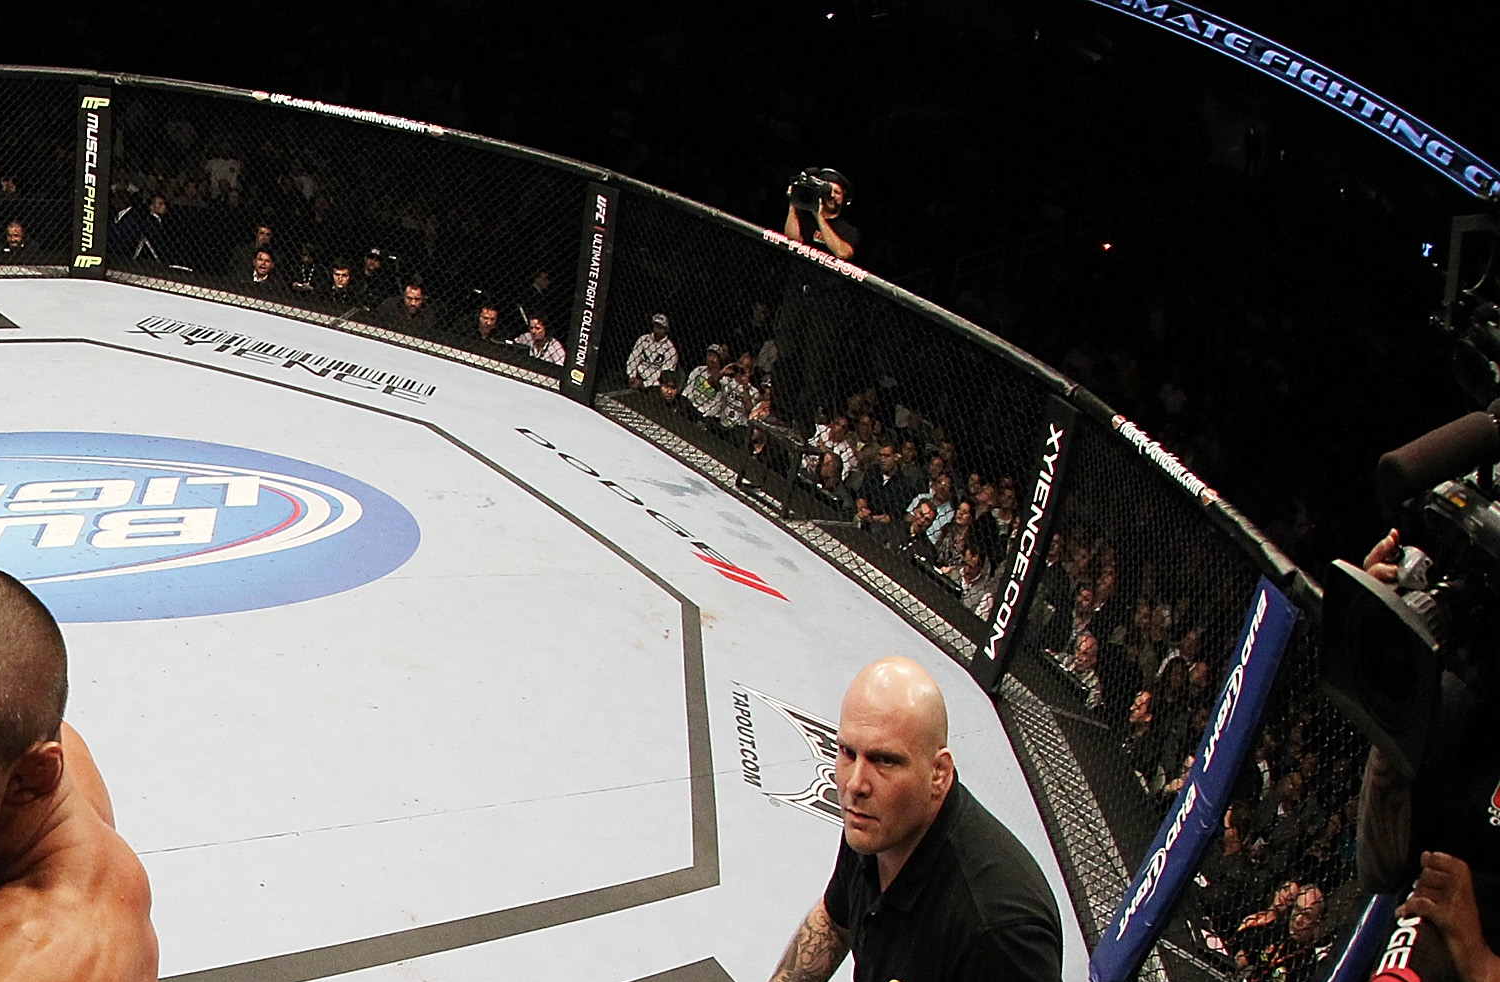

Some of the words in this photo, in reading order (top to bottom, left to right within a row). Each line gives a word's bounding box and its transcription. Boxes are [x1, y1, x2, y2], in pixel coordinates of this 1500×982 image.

[270, 92, 426, 133] UFC.com/hometownthrowdown
[1120, 0, 1252, 53] MATE
[1260, 50, 1454, 166] FIGHTING
[594, 194, 607, 224] UFC
[585, 279, 598, 309] FIGHT
[587, 233, 604, 280] ULTIMATE
[788, 239, 868, 282] PAVILION
[124, 322, 426, 405] XYIENCE
[575, 309, 593, 367] COLLECTION
[1119, 420, 1206, 497] Harley-Davidson.com
[515, 428, 738, 568] DODGE
[984, 423, 1064, 660] XYIENCE.COM
[1241, 589, 1267, 667] BUD
[732, 690, 762, 788] TAPOUT.COM
[1203, 675, 1242, 772] LIGHT
[1166, 782, 1197, 851] BUD
[1116, 855, 1163, 941] LIGHT
